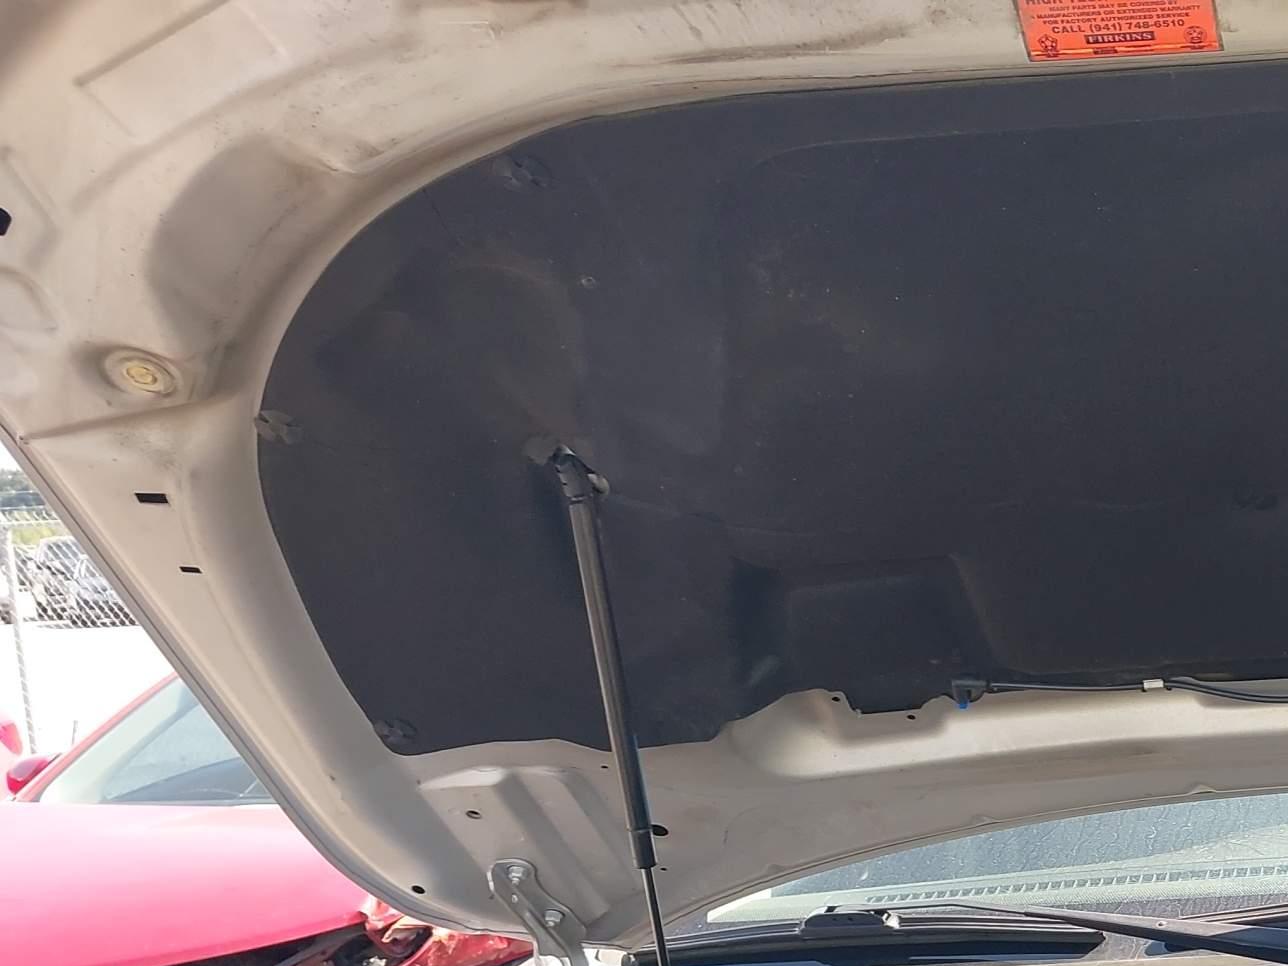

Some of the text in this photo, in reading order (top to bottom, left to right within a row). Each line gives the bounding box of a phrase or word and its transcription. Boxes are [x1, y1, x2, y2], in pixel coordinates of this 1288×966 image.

[1051, 19, 1185, 34] CALL (941) 748-6510
[1087, 32, 1152, 43] FIRKINS
